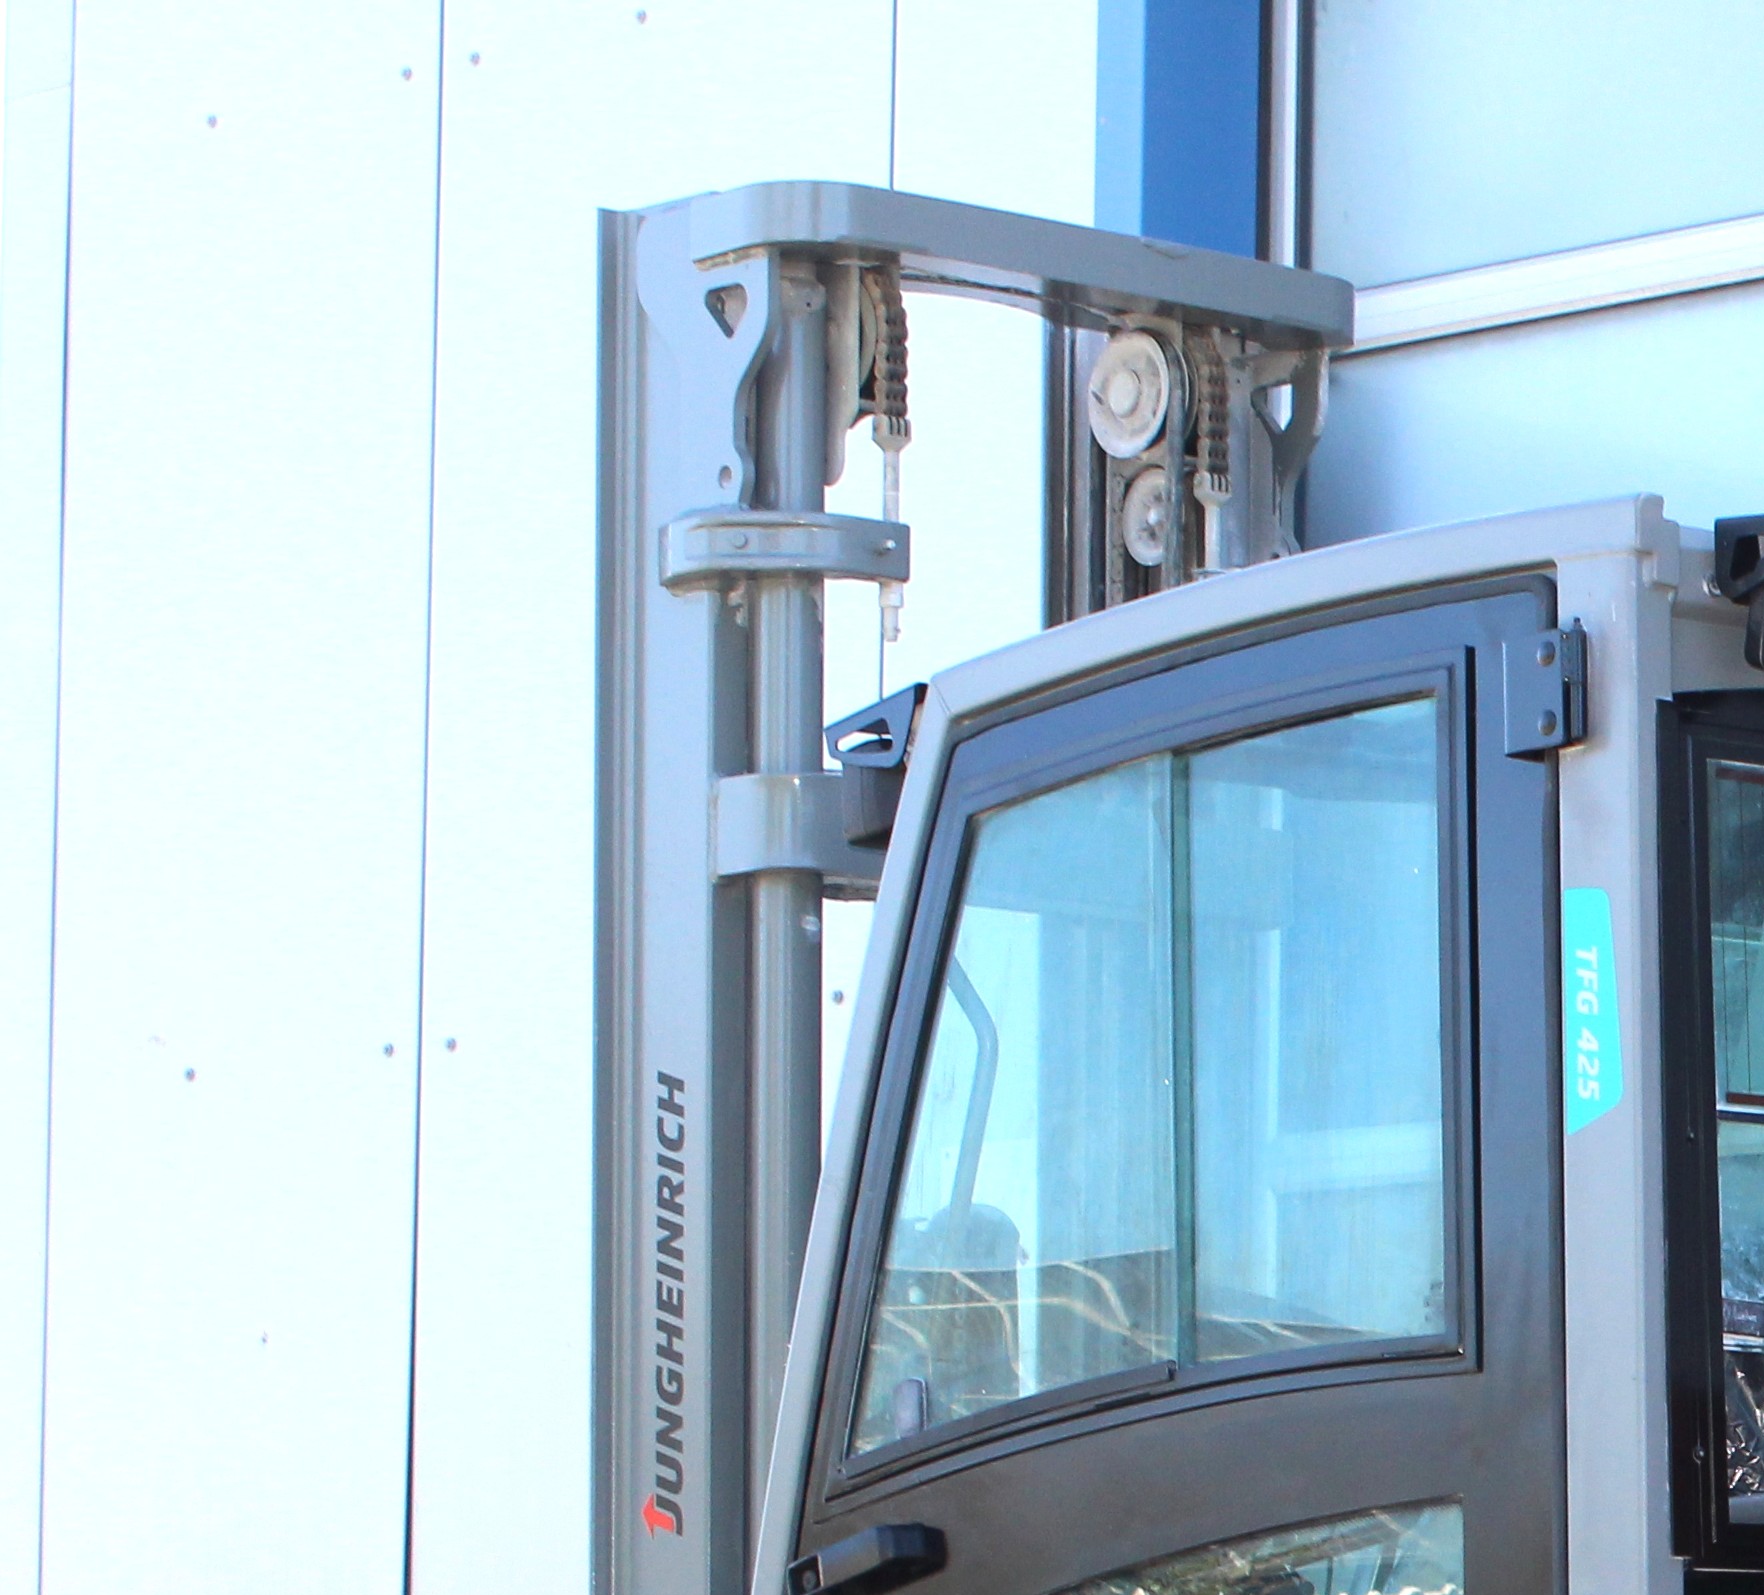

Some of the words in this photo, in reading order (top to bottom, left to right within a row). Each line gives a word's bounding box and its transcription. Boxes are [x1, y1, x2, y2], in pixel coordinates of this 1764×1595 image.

[1574, 945, 1599, 1017] TFG
[1576, 1028, 1601, 1103] 425
[654, 1070, 686, 1538] JUNGHEINRICH
